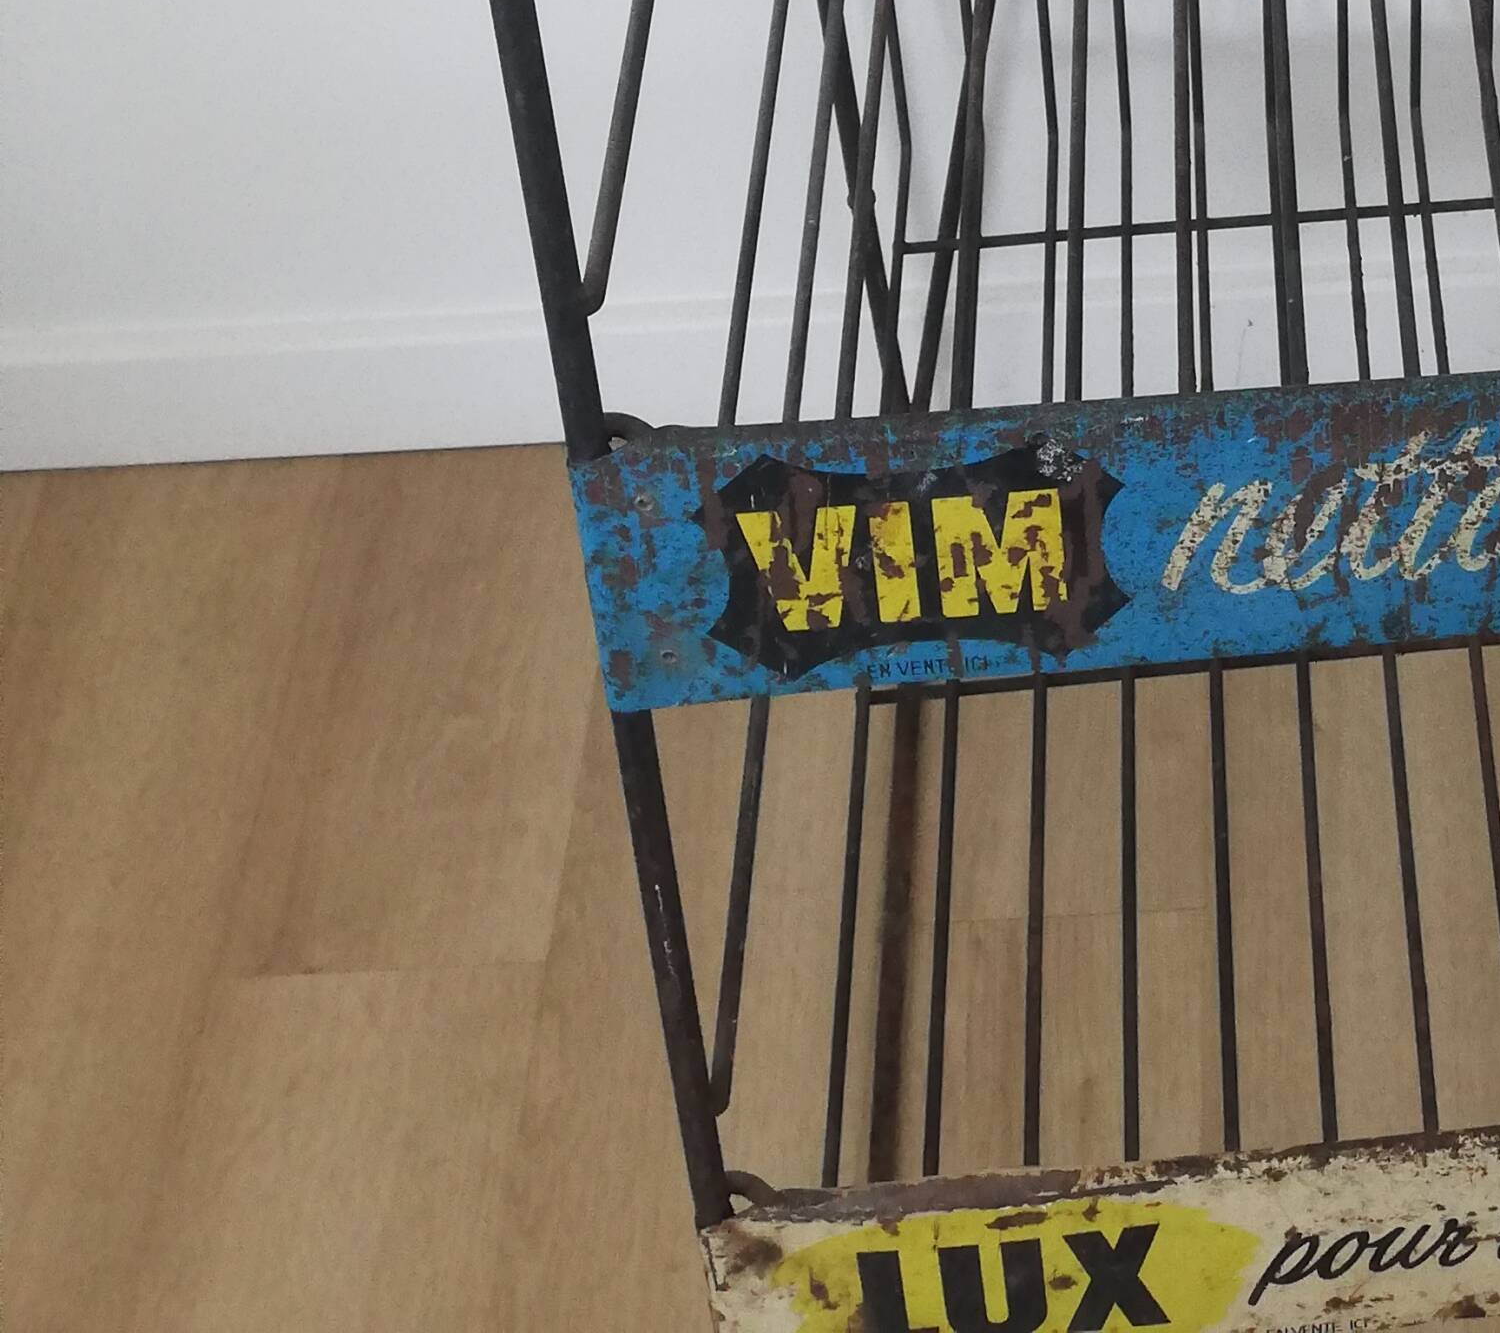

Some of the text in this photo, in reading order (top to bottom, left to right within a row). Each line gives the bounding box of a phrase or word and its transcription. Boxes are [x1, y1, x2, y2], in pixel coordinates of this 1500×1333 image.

[735, 488, 1069, 632] VIM
[867, 663, 891, 679] EN
[896, 658, 952, 677] VENT
[856, 1223, 1172, 1333] LUX
[1248, 1217, 1478, 1307] pour
